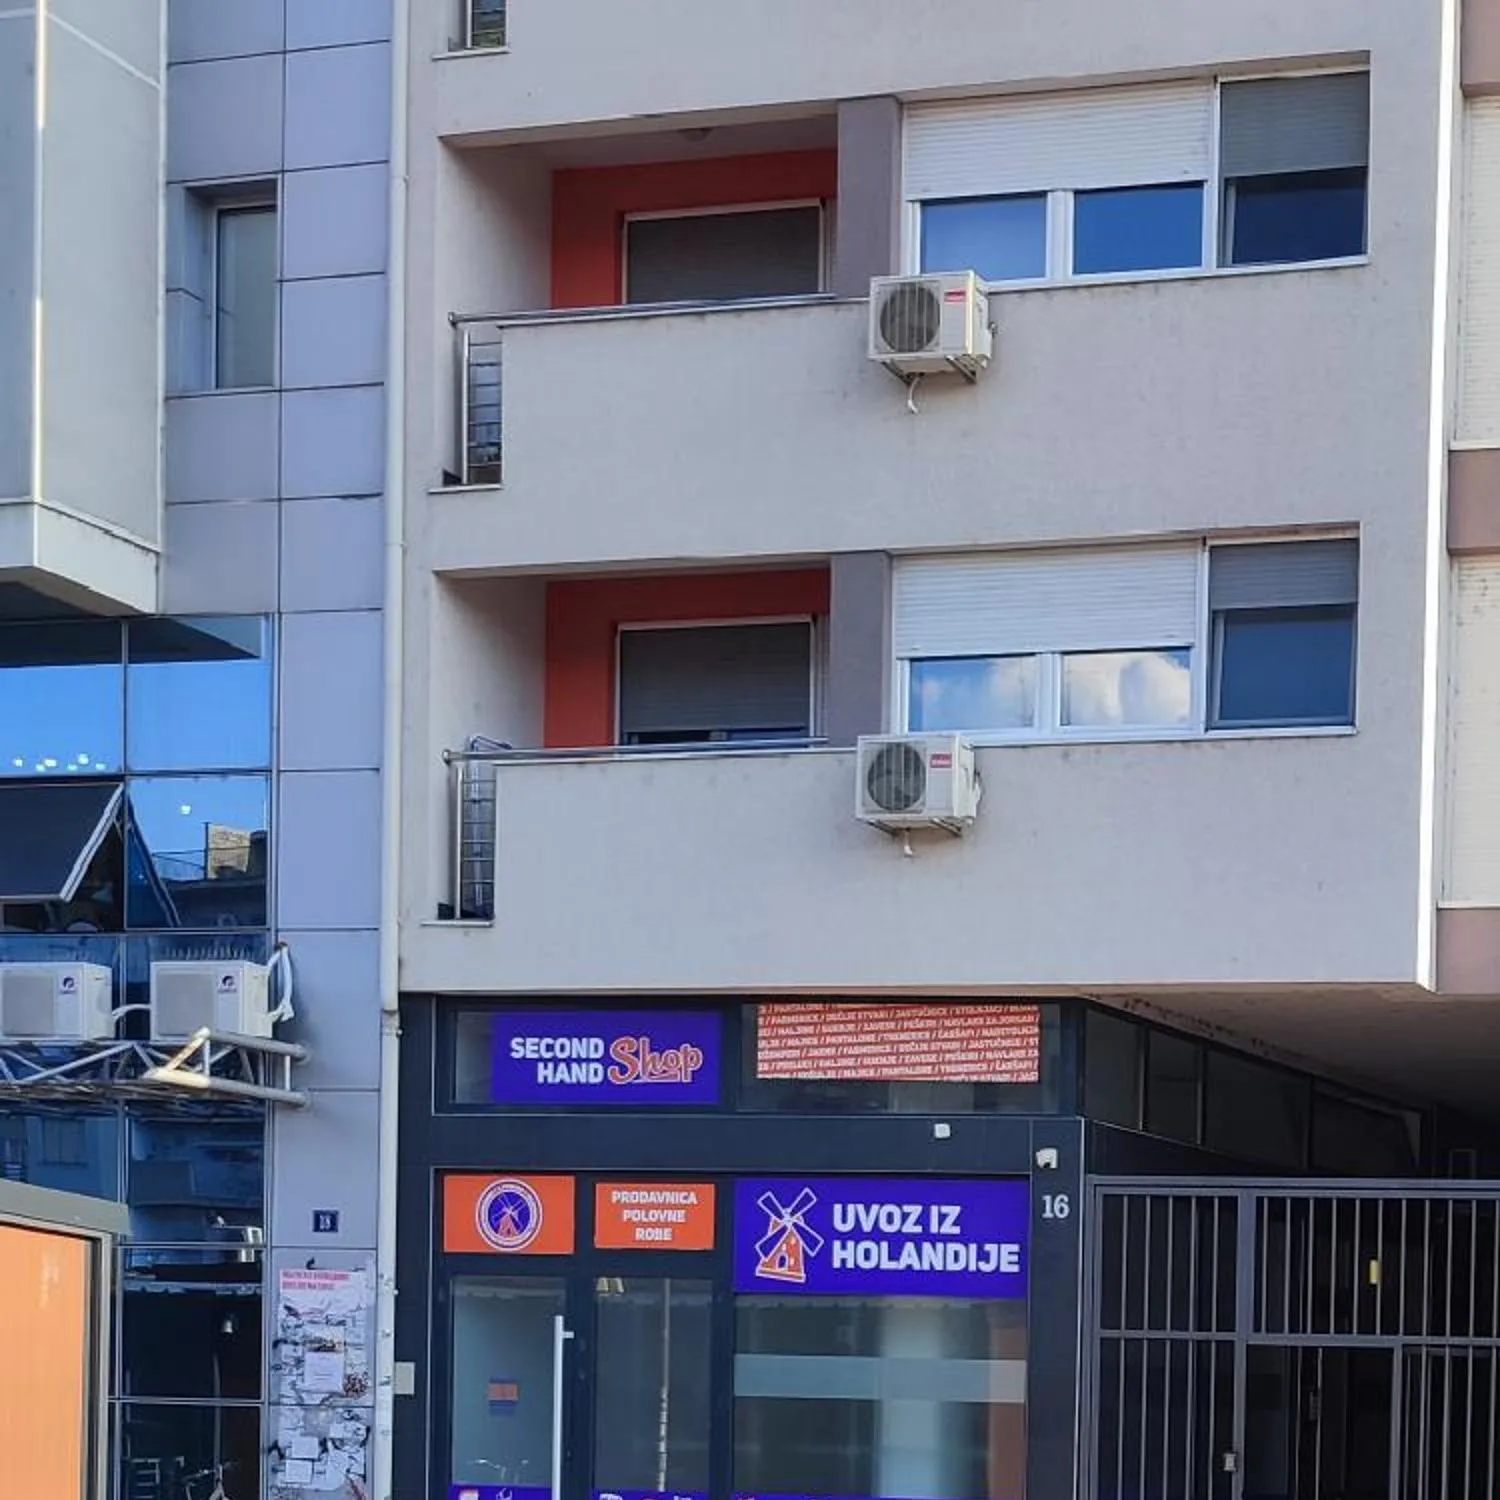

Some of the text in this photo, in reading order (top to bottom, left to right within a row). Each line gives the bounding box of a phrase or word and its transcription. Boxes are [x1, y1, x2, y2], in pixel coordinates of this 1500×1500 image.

[510, 1037, 605, 1059] SECOND
[607, 1036, 703, 1084] Shop
[537, 1062, 605, 1083] HAND
[611, 1191, 697, 1205] PRODAVNICA
[1041, 1194, 1070, 1219] 16
[622, 1209, 686, 1223] POLOVNE
[833, 1203, 961, 1234] UVOZ IZ
[832, 1240, 1020, 1273] HOLANDIJE
